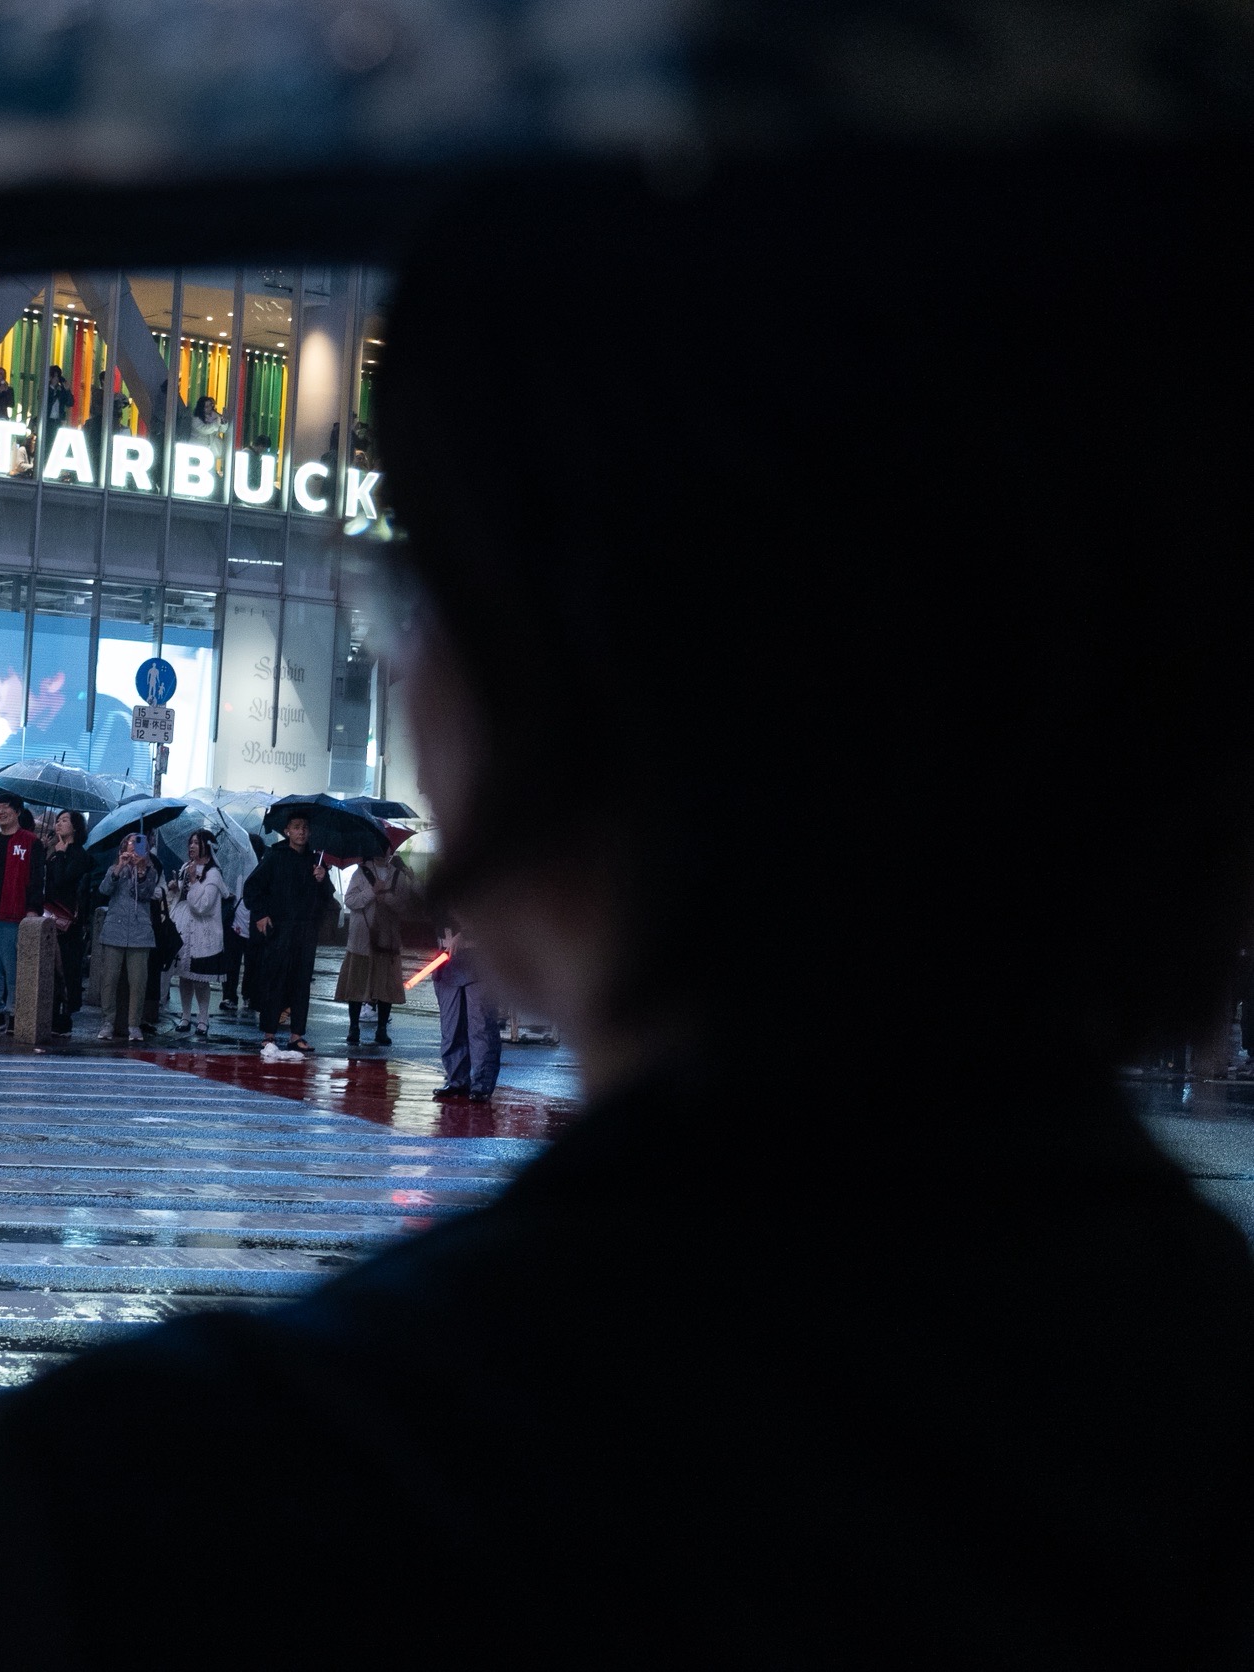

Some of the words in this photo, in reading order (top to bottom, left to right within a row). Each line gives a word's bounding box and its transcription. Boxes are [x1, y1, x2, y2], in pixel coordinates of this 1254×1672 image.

[138, 707, 147, 718] 15
[165, 710, 171, 720] 5
[248, 697, 305, 728] Yenjun
[136, 729, 145, 740] 12
[163, 732, 169, 742] 5
[12, 844, 27, 861] NY
